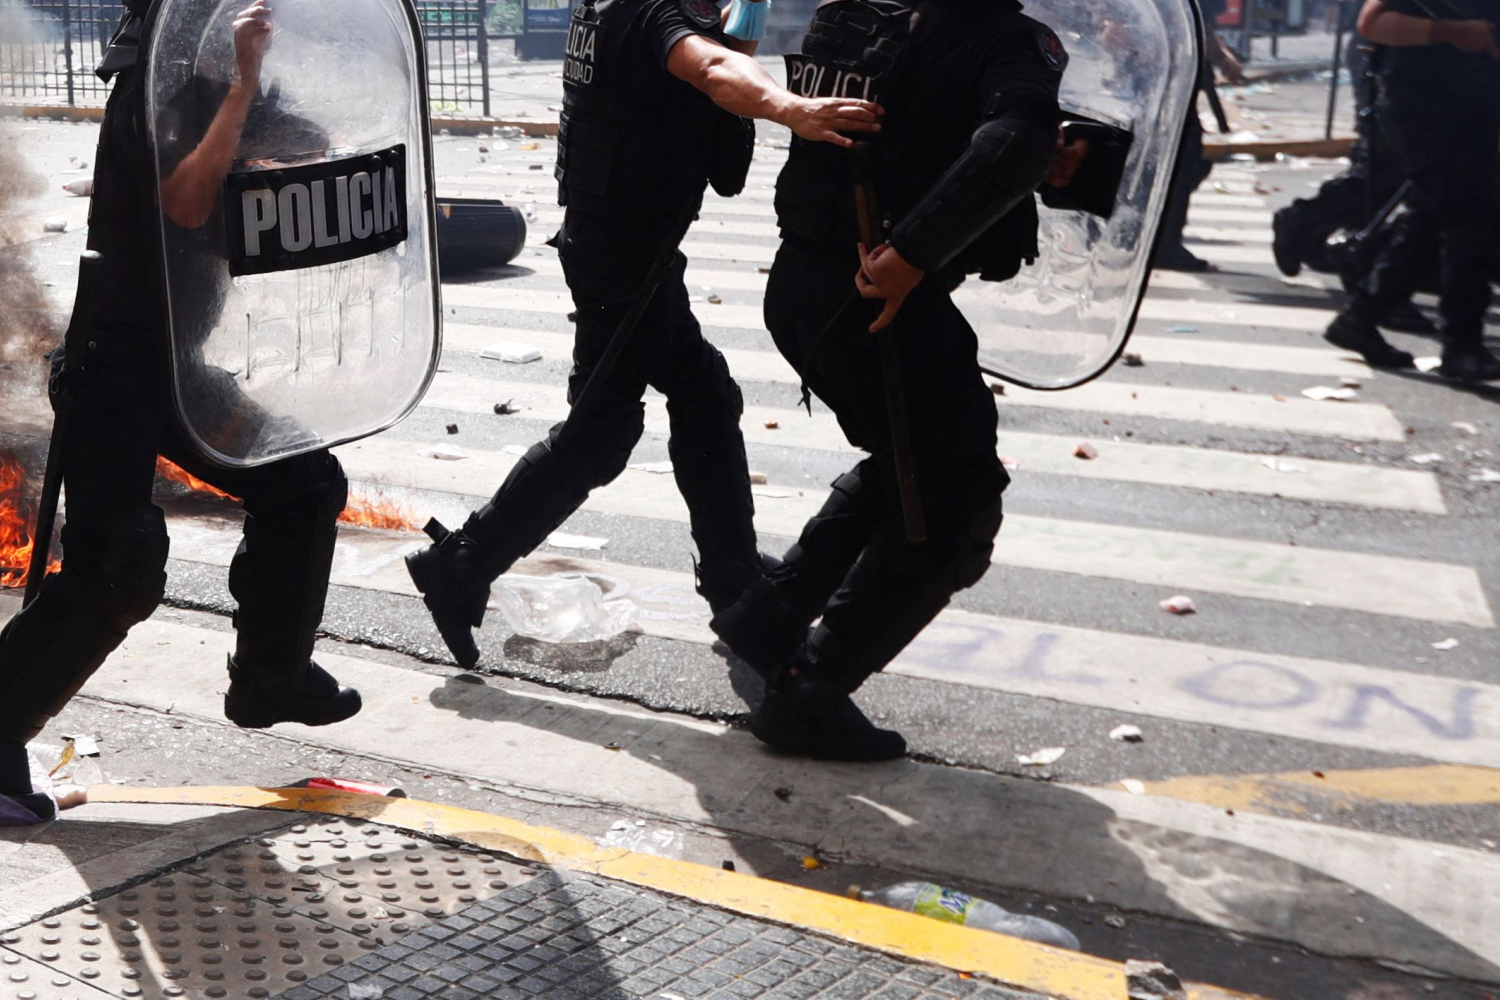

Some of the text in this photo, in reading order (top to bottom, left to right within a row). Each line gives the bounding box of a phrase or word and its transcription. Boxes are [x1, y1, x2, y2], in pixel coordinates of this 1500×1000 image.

[566, 21, 596, 62] LICIA
[788, 60, 878, 102] POLICI
[241, 166, 399, 257] POLICIA
